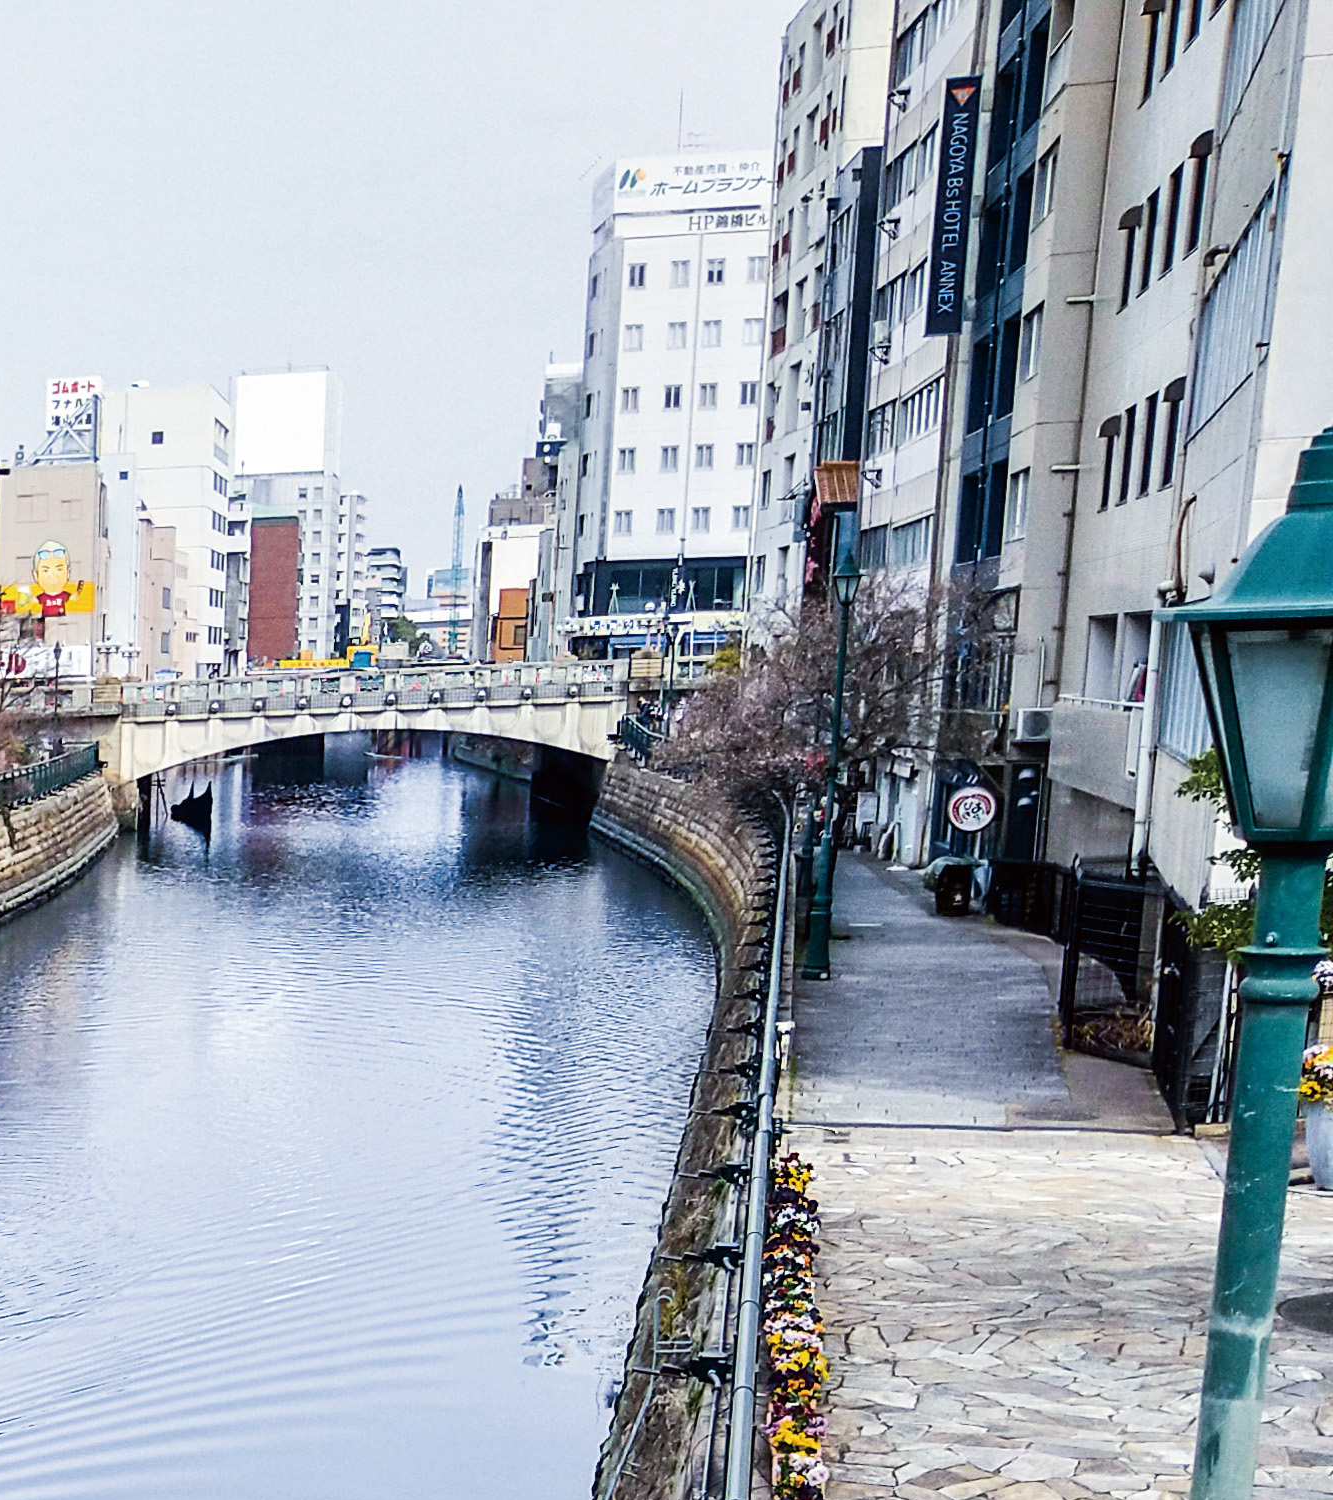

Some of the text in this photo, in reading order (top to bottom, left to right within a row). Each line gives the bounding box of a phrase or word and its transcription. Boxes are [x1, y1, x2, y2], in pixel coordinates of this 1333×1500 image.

[948, 112, 970, 175] NAGOYA
[941, 201, 962, 252] HOTEL
[937, 260, 957, 313] ANNEX
[52, 380, 96, 394] ゴムボート
